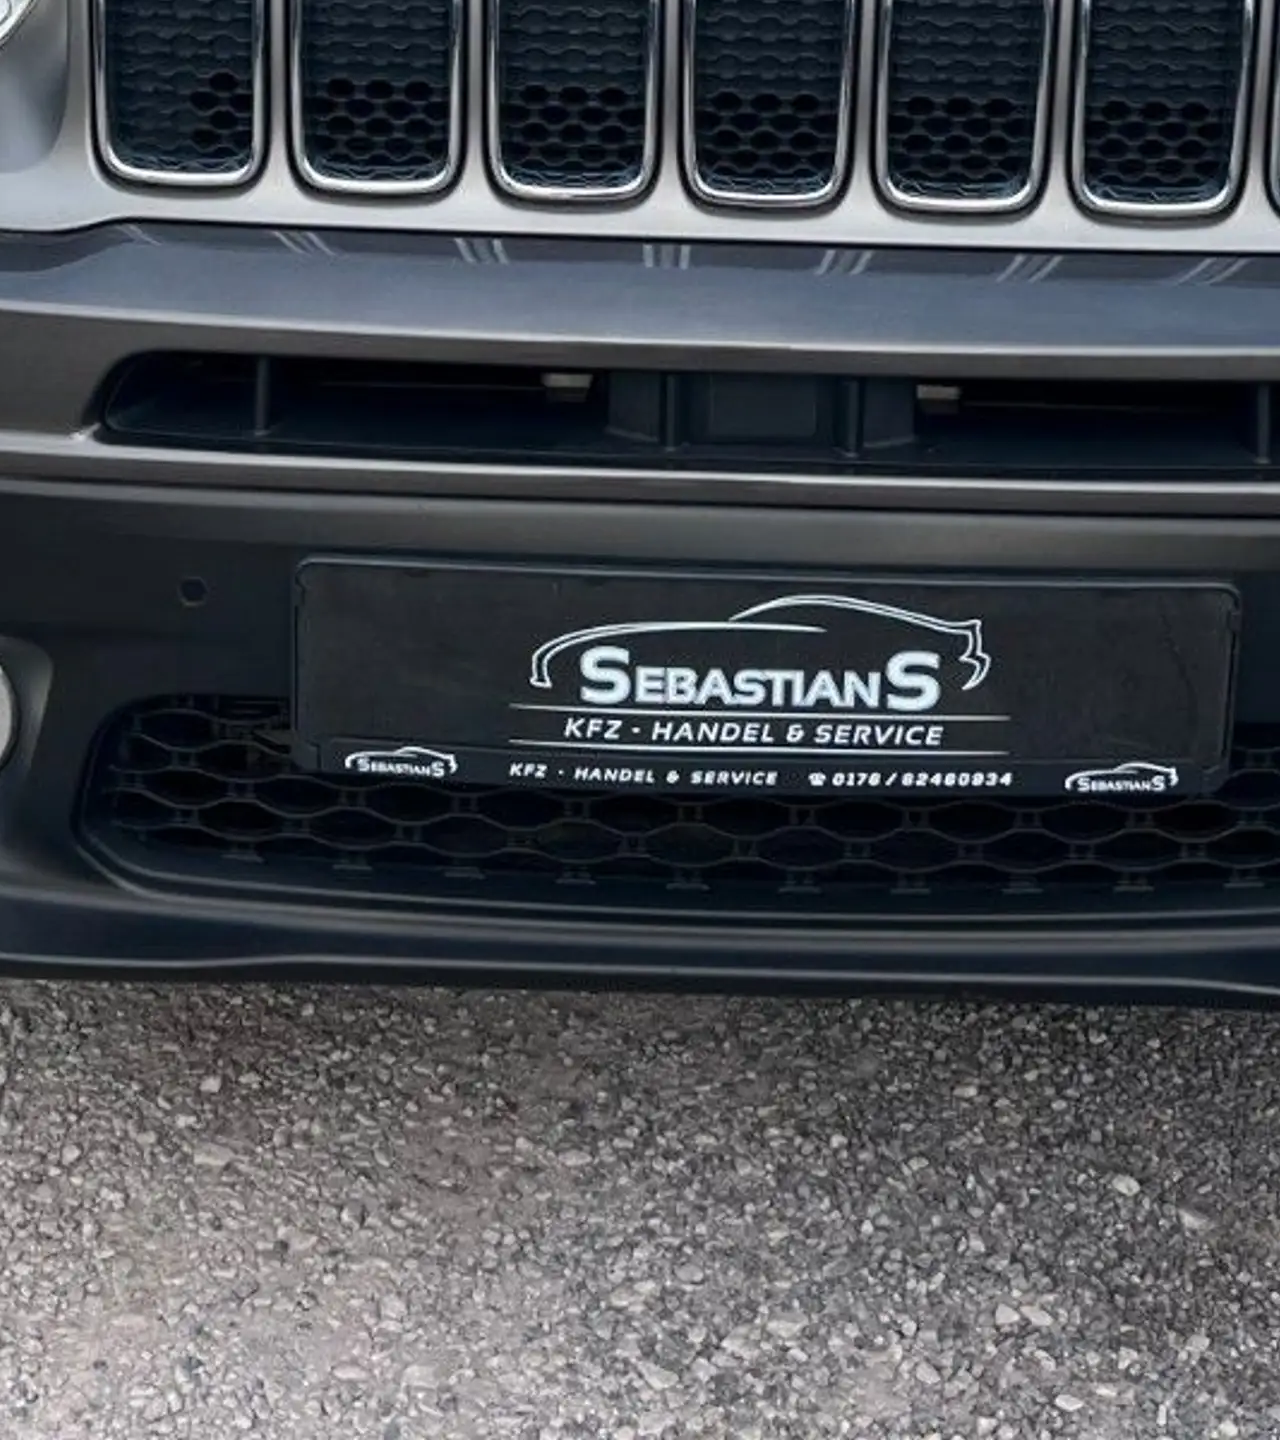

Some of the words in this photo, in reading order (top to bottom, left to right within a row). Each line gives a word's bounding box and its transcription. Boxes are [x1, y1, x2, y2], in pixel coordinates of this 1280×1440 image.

[579, 645, 942, 712] SEBASTIANS
[563, 716, 623, 740] KFZ
[651, 720, 775, 744] HANDEL
[785, 722, 805, 743] &
[813, 723, 944, 746] SERVICE
[508, 762, 549, 779] KFZ
[573, 766, 656, 784] HANDEL
[690, 769, 779, 787] SERVICE
[1076, 773, 1166, 793] SEBASTIANS
